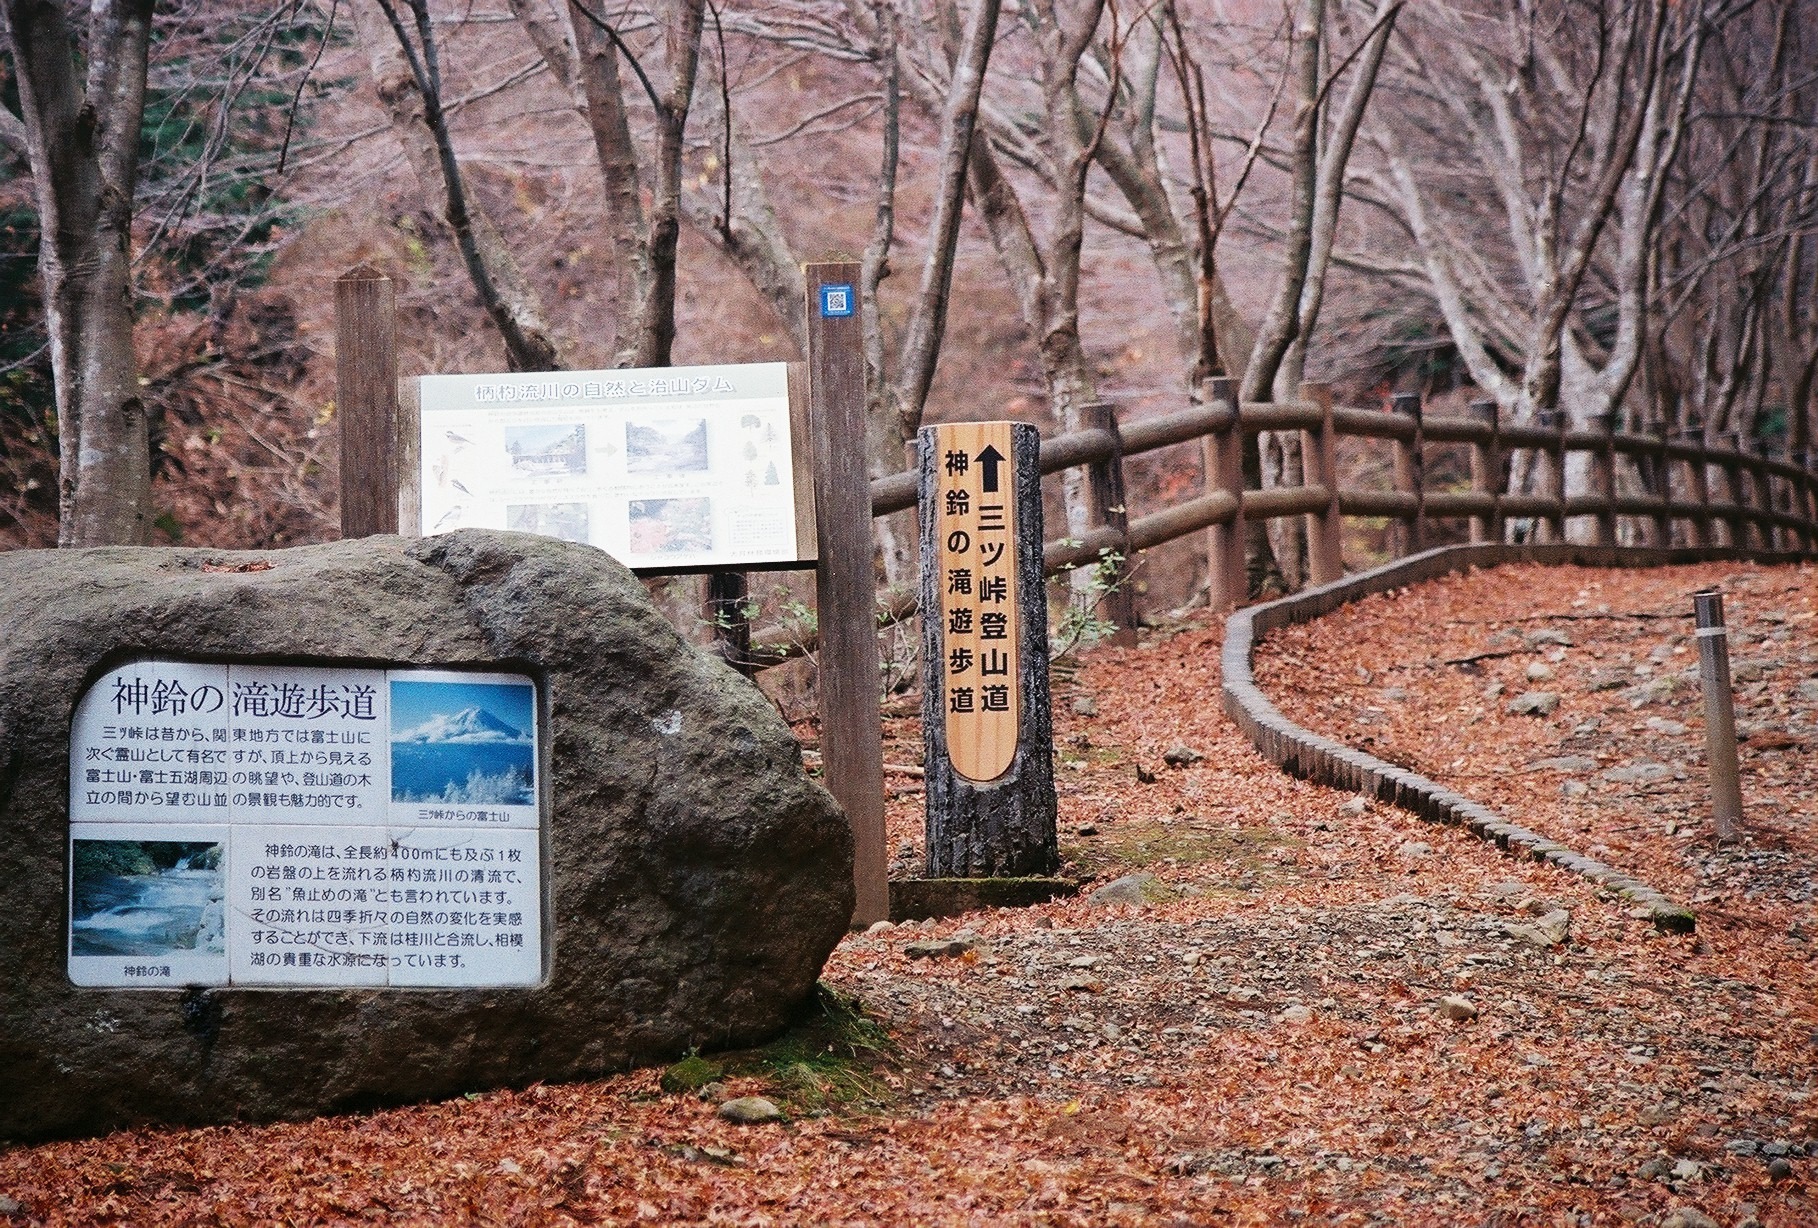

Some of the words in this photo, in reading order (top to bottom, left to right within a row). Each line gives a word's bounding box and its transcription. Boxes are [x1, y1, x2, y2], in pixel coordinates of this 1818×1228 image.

[474, 376, 736, 402] 柄杓流川の自然と治山ダム
[944, 449, 974, 713] 神鈴の滝遊歩道
[977, 504, 1009, 713] 三ツ峠登山道
[110, 676, 378, 721] 神鈴の滝遊歩道
[251, 908, 523, 926] その流れは四季折々の自然の変化を実感
[123, 965, 171, 978] 神鈴の滝
[250, 951, 466, 969] 湖の貴重な水源になっています。
